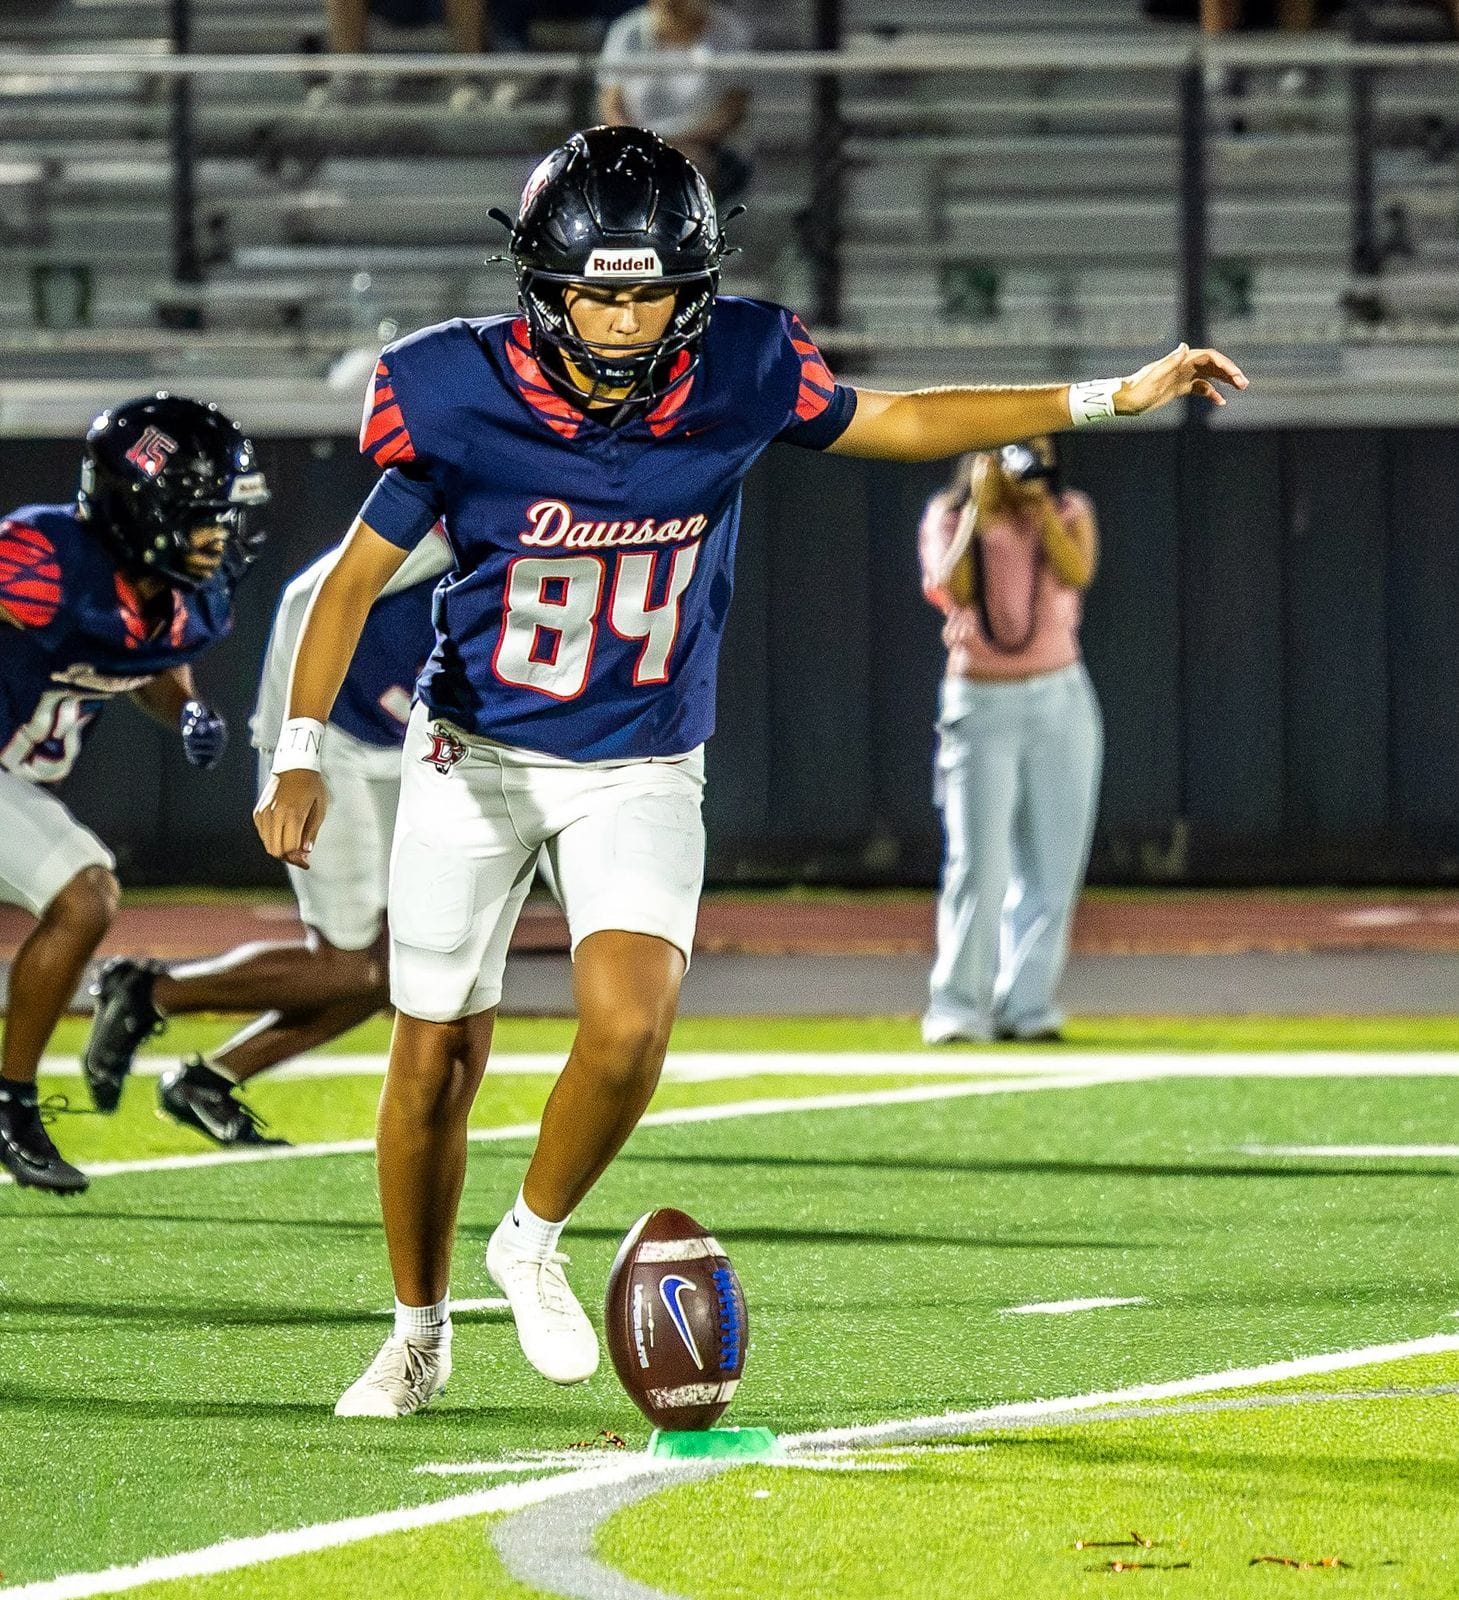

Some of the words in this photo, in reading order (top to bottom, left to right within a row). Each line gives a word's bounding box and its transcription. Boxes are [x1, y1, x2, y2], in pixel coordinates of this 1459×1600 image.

[593, 257, 655, 271] Riddell
[126, 424, 179, 478] 15
[519, 498, 708, 548] Dawson
[491, 540, 701, 702] 84
